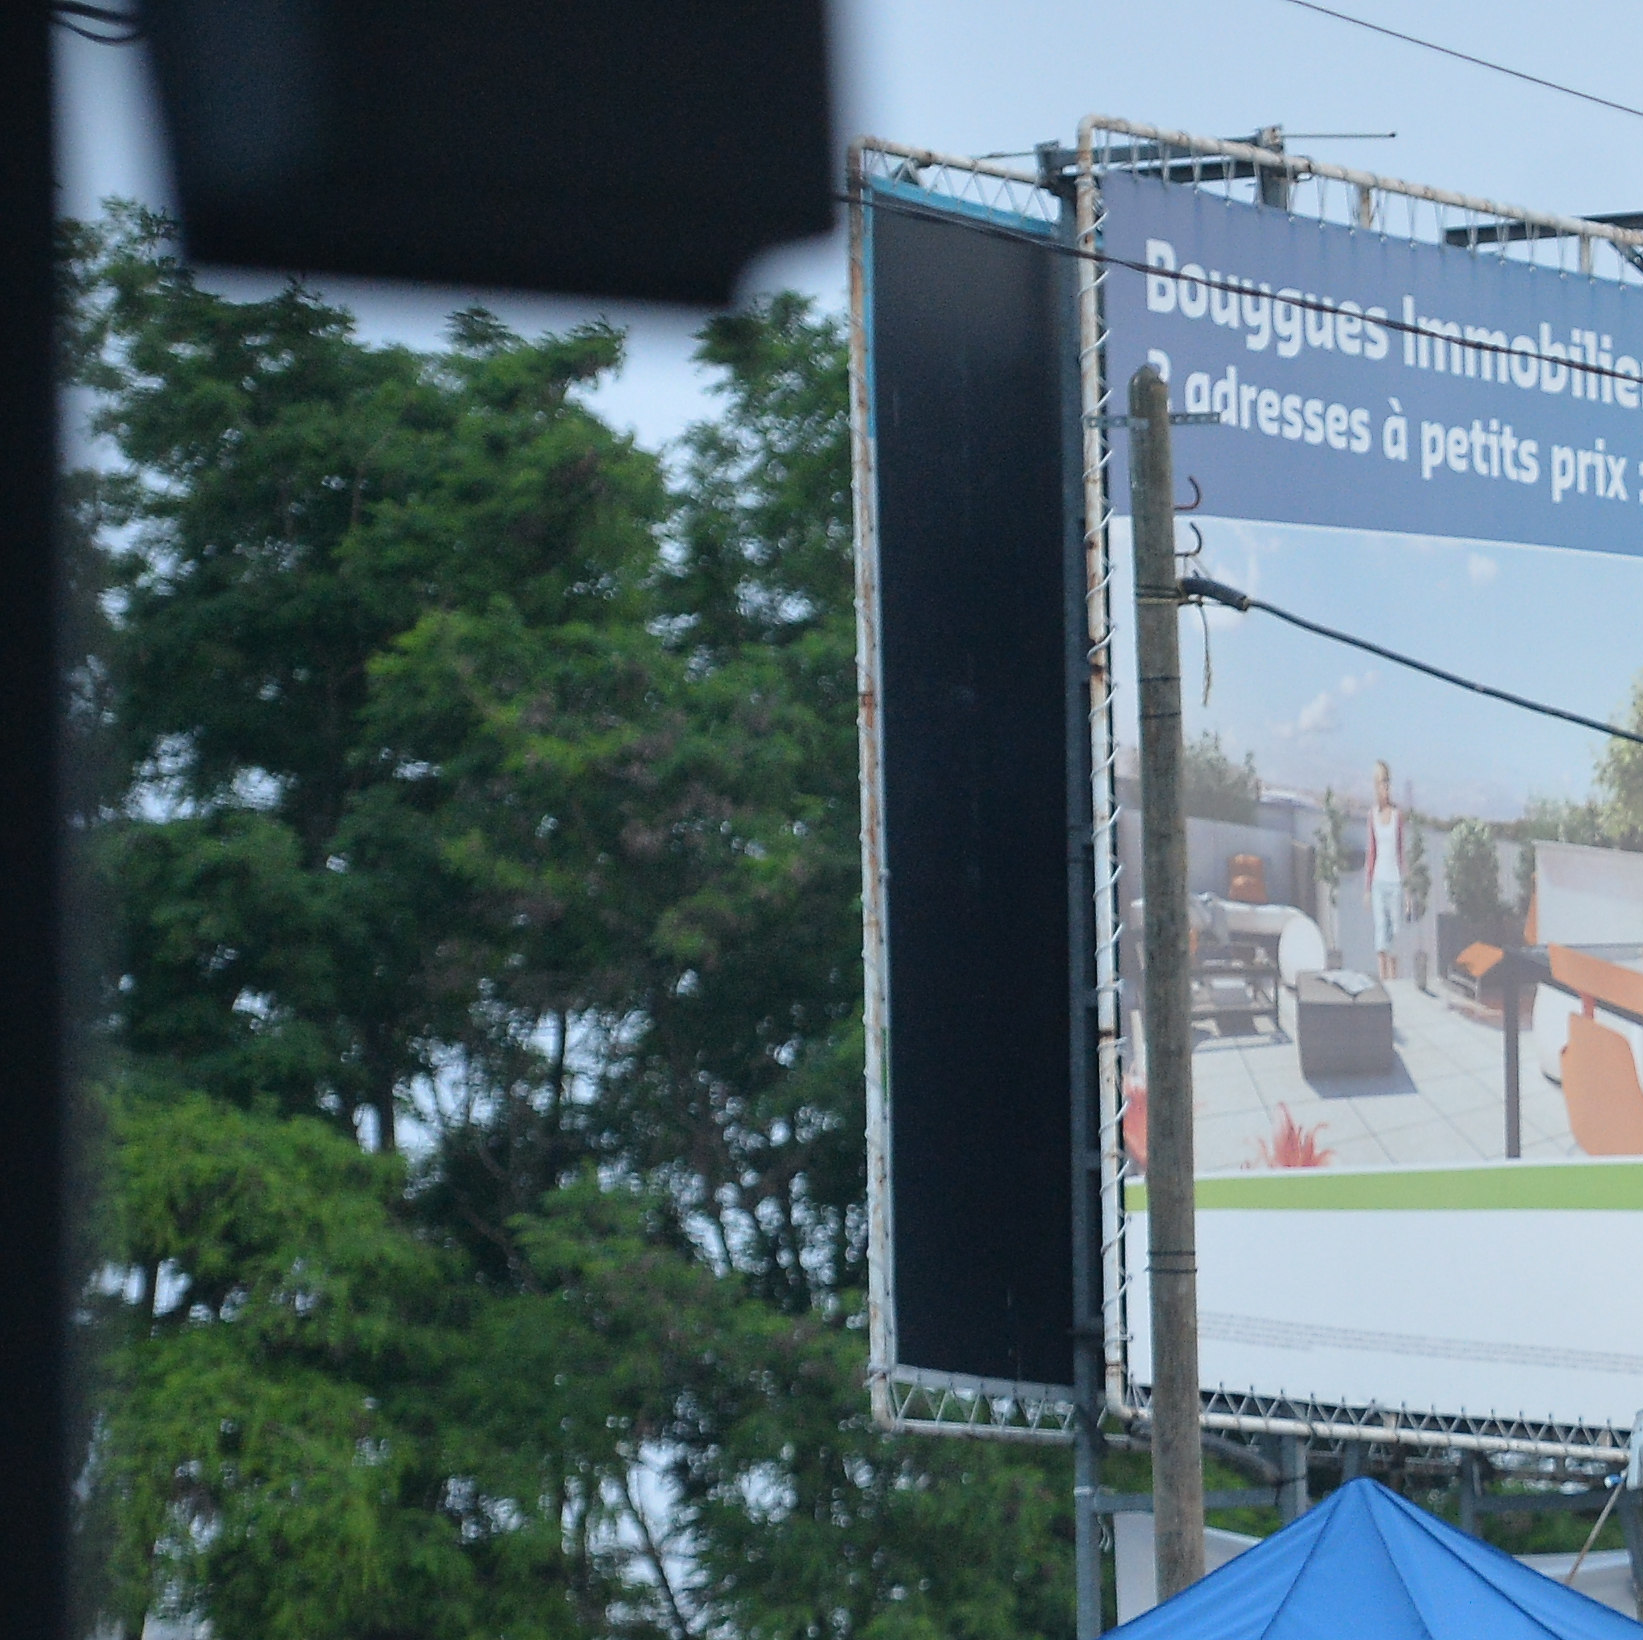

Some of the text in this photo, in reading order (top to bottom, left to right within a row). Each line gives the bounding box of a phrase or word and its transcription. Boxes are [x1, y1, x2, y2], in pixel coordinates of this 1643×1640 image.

[1146, 238, 1391, 361] Bouygues
[1184, 365, 1372, 454] adresses
[1382, 397, 1408, 462] à
[1420, 418, 1541, 484] petits
[1551, 438, 1629, 503] prix
